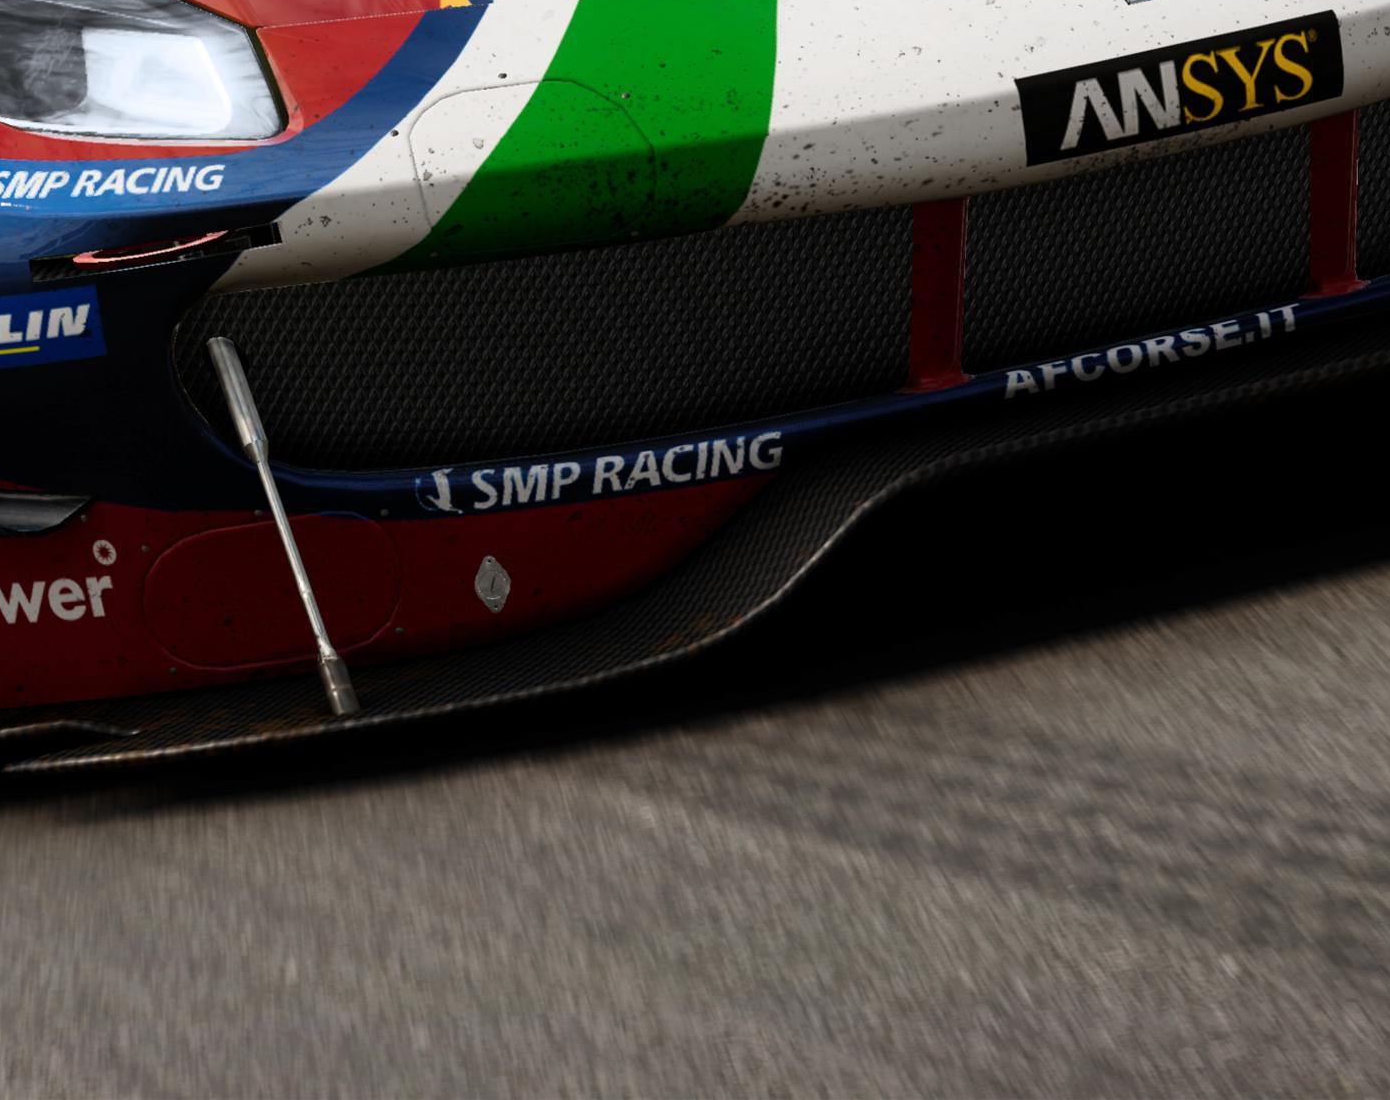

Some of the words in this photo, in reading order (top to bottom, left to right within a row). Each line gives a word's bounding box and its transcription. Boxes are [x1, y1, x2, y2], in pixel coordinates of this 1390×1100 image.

[1060, 30, 1313, 151] ANSYS
[70, 164, 225, 197] RACING
[1004, 302, 1301, 401] AFCORSE.IT
[471, 460, 581, 511] SMP
[593, 432, 783, 496] RACING
